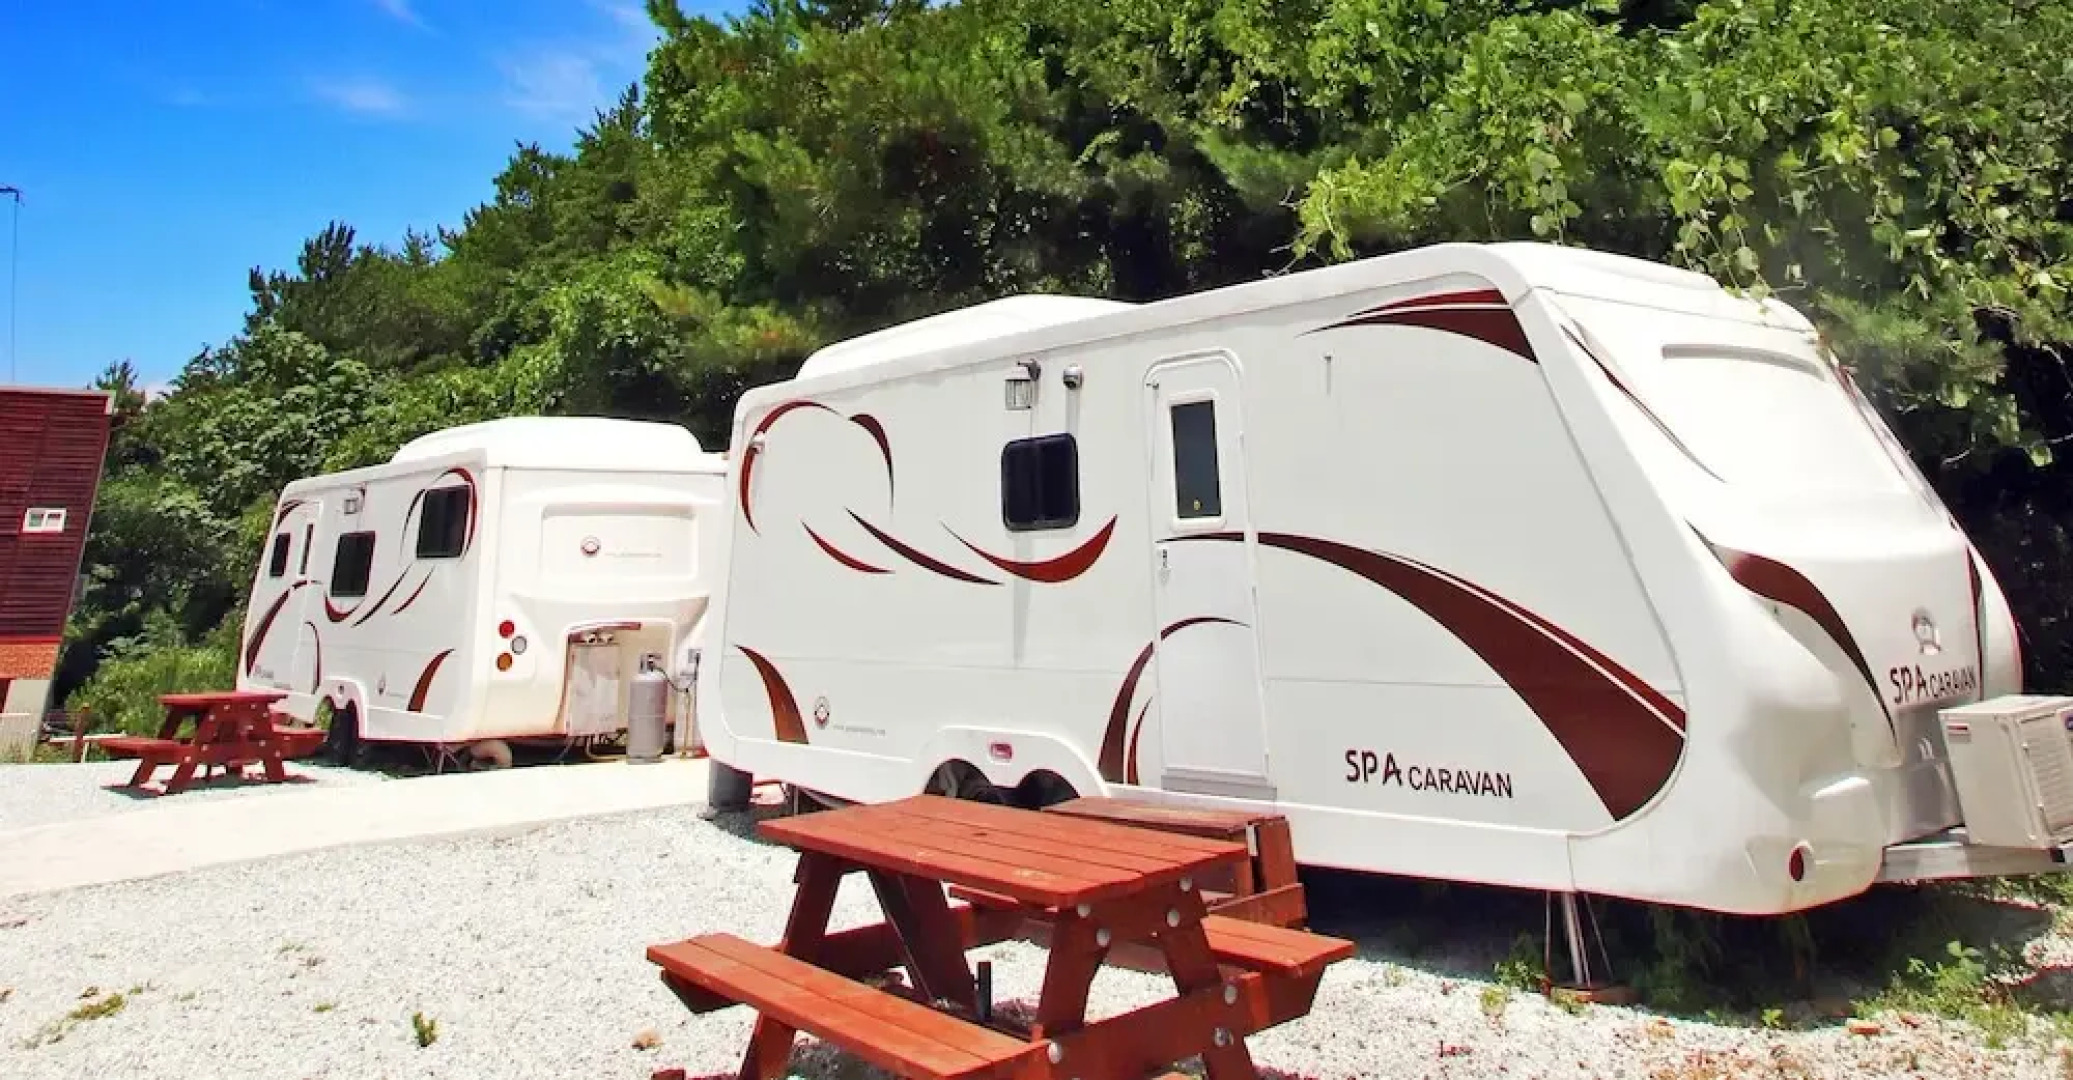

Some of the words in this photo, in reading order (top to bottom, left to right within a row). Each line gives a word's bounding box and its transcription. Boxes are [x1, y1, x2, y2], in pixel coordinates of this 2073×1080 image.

[1889, 664, 1929, 703] SPA
[1930, 665, 1976, 699] CARAVAN
[1345, 750, 1403, 786] SPA
[1408, 766, 1513, 798] CARAVAN
